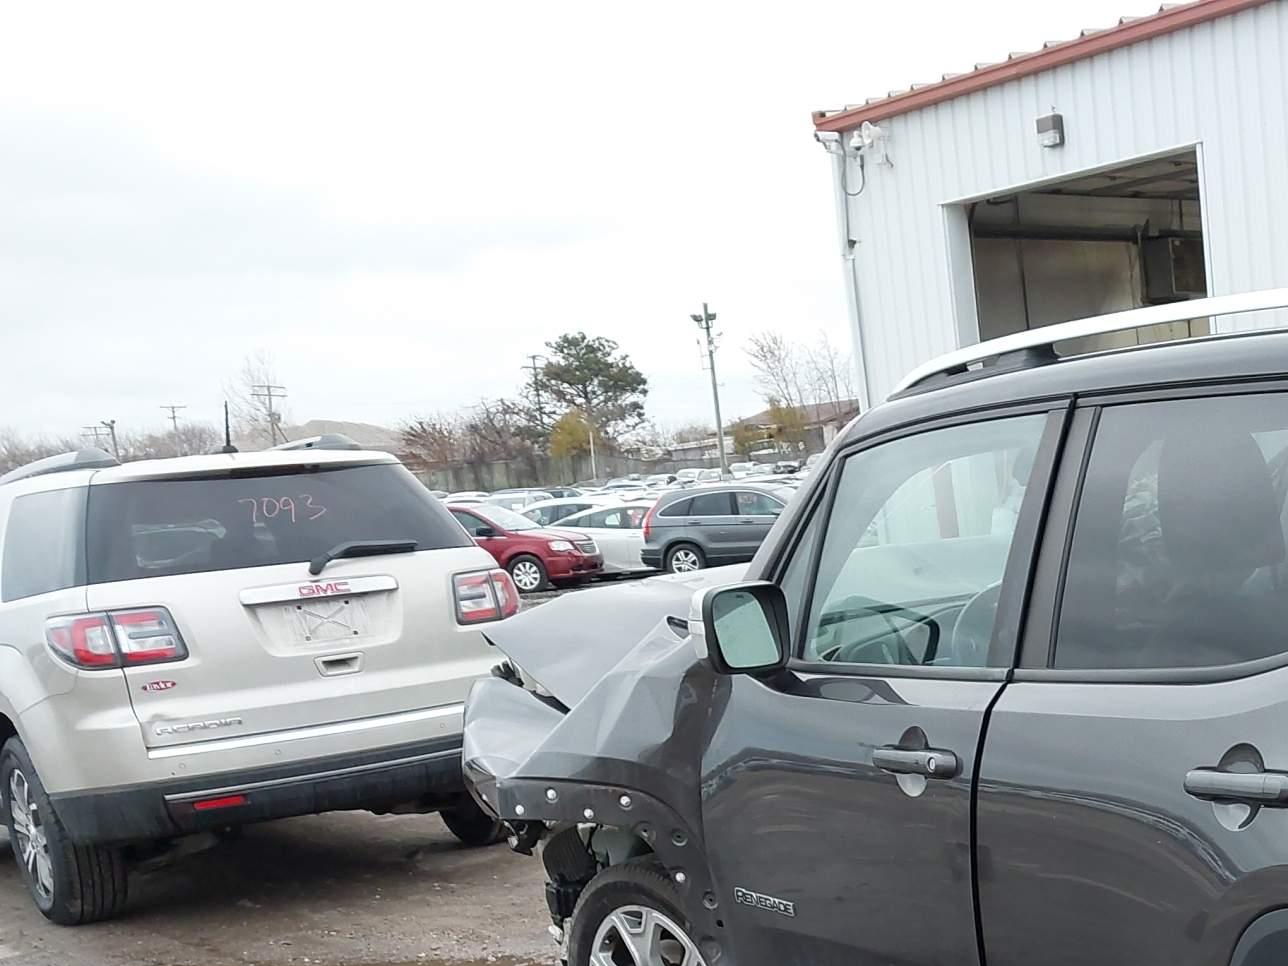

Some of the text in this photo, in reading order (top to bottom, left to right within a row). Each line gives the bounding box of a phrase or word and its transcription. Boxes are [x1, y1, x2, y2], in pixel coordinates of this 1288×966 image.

[237, 494, 327, 523] 7093
[298, 581, 352, 597] GMC
[734, 887, 796, 917] RENEGADE
